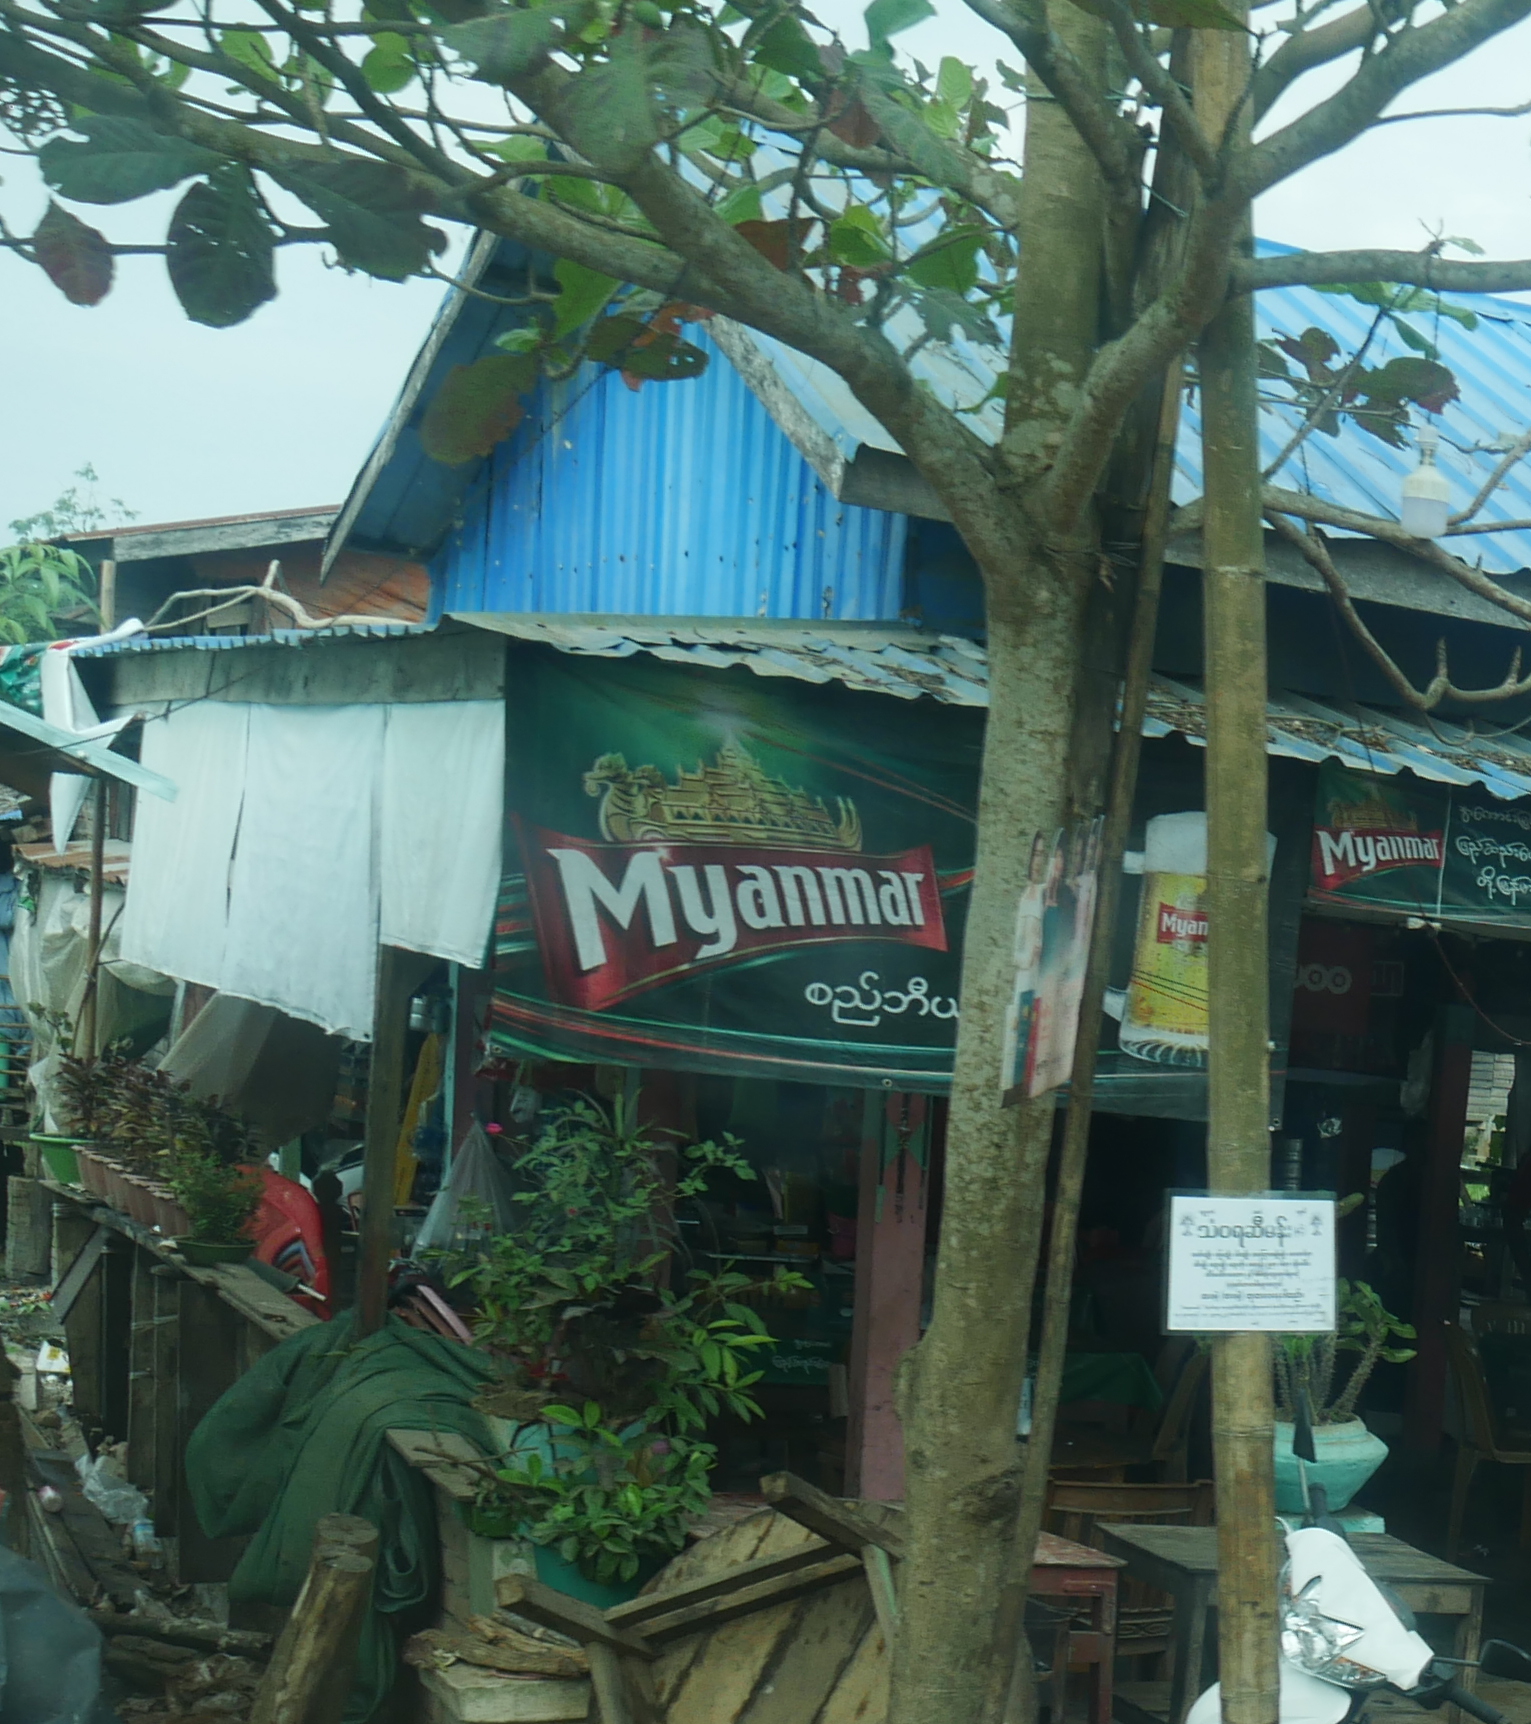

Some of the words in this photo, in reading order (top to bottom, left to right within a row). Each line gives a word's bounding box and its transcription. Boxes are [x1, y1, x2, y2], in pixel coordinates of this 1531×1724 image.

[1315, 830, 1439, 876] Myanmar
[546, 848, 925, 973] Myanmar
[1161, 912, 1208, 938] Myan
[804, 971, 962, 1027] စည်ဘီယ
